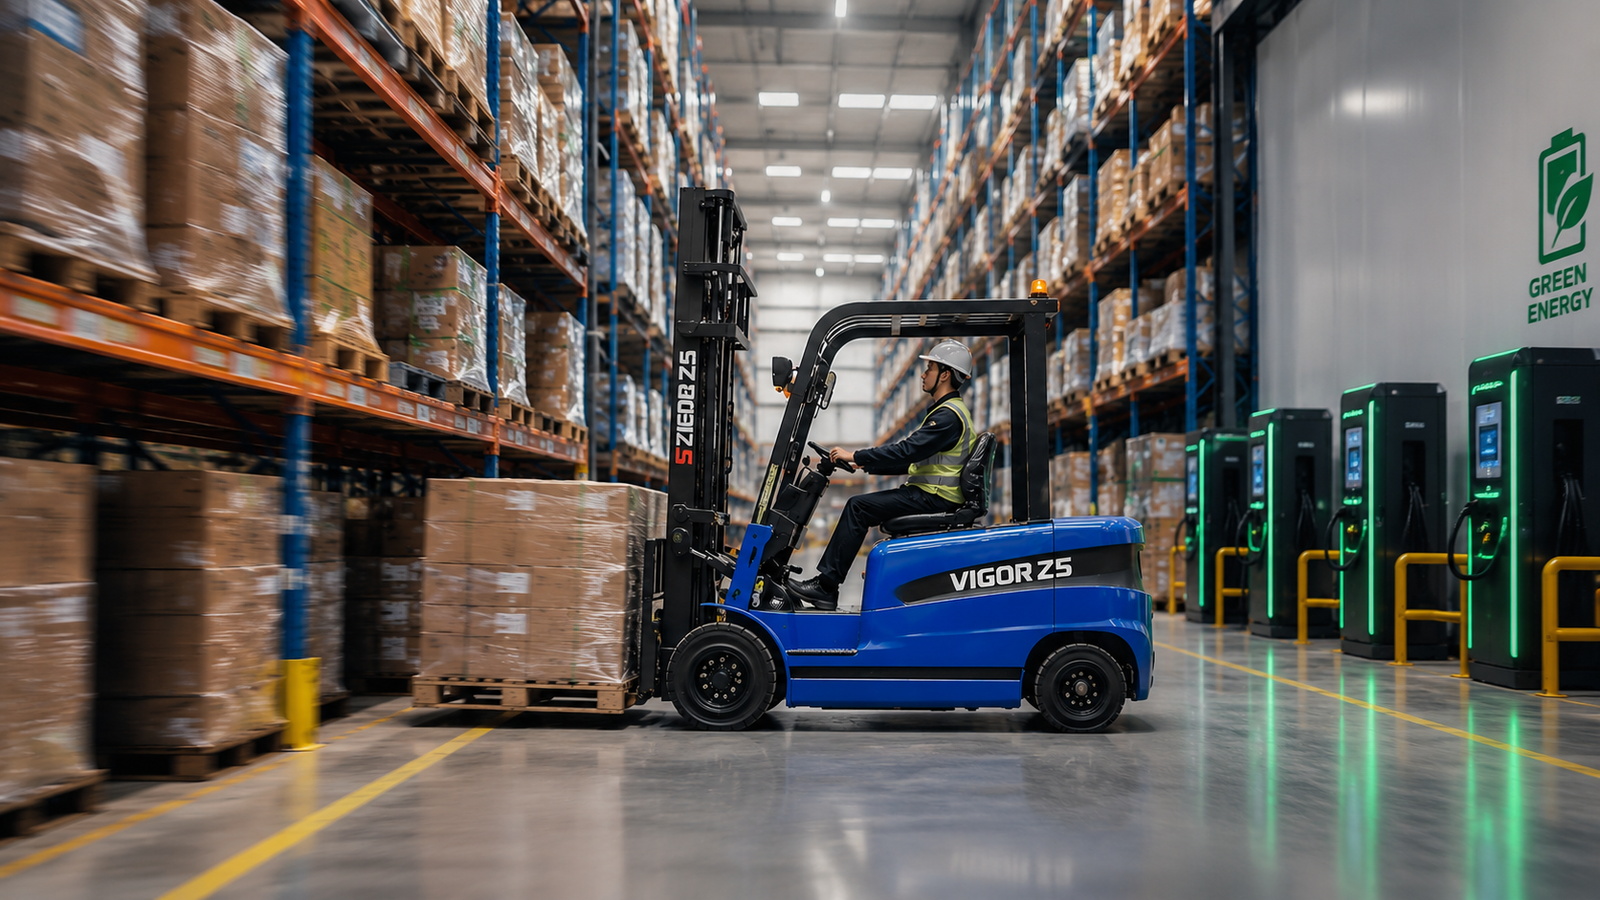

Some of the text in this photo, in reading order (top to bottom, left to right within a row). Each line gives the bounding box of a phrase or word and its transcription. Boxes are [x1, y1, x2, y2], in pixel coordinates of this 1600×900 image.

[1529, 262, 1587, 298] GREEN
[1528, 287, 1594, 324] ENERGY
[678, 350, 697, 381] Z5
[950, 557, 1073, 591] VIGOR Z5
